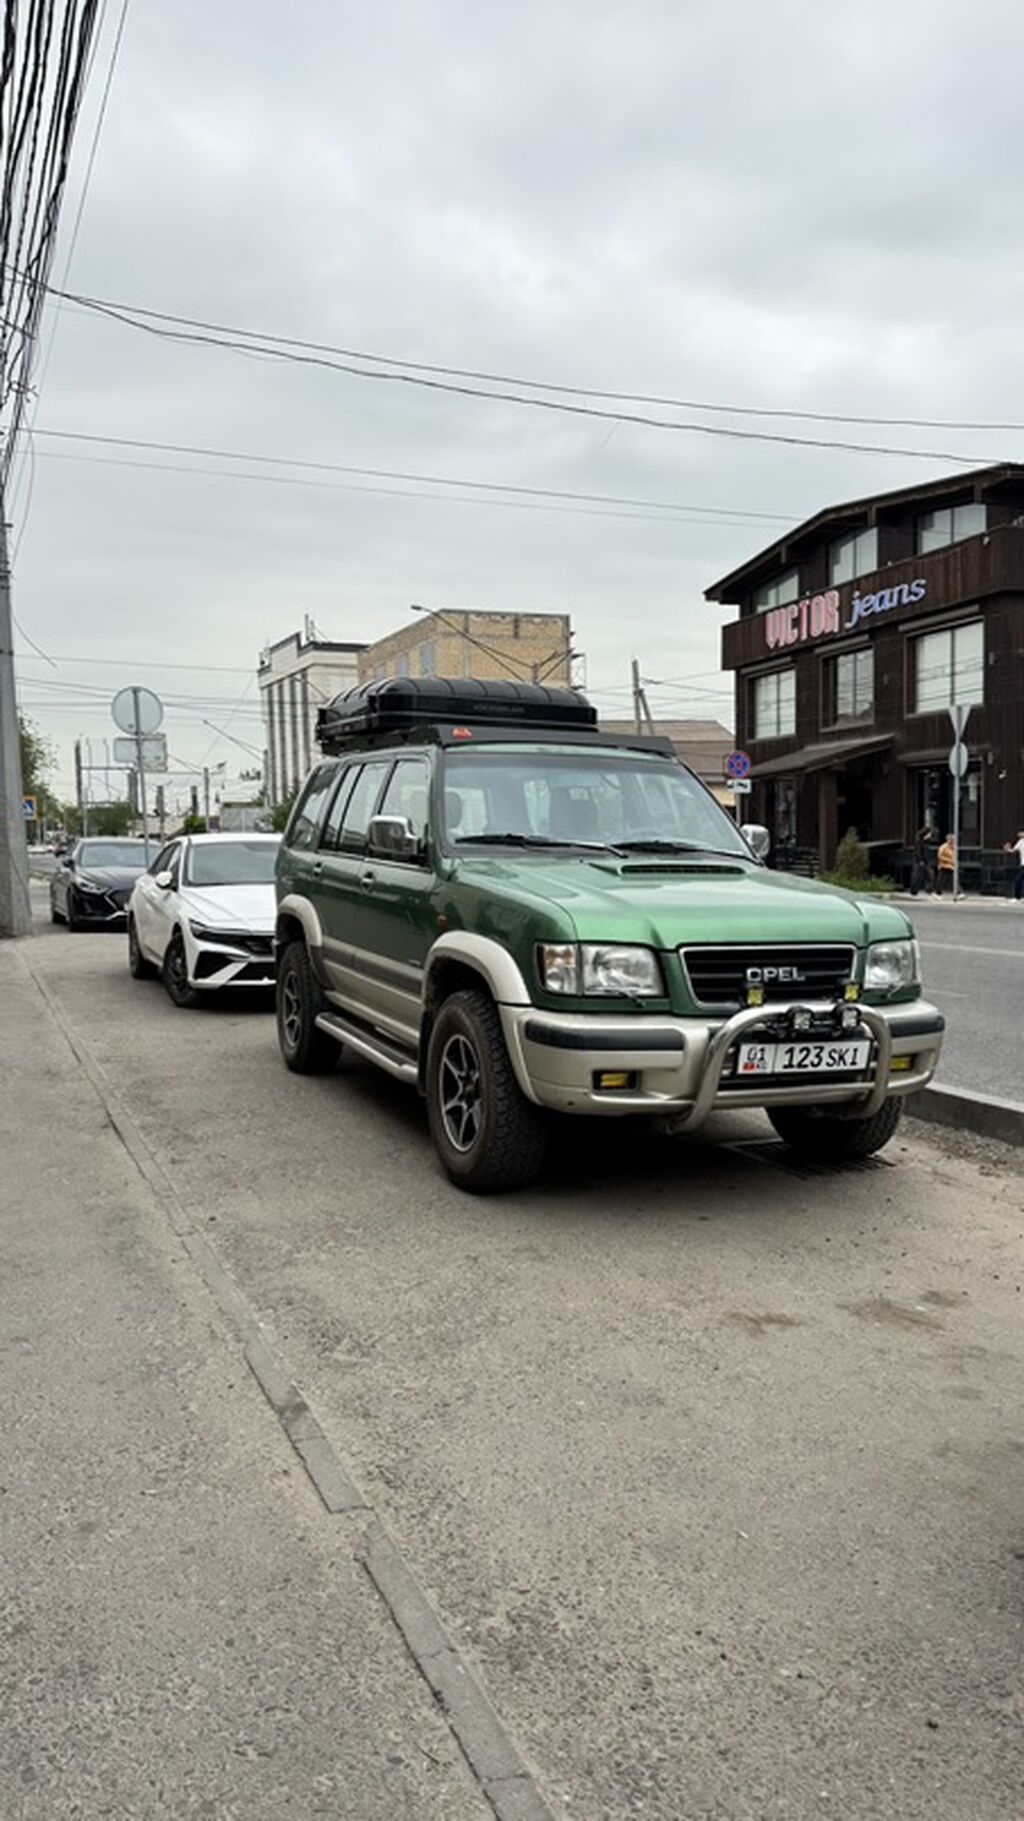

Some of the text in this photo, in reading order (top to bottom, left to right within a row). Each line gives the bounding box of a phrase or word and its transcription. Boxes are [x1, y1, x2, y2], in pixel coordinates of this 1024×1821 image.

[765, 579, 926, 648] VICTOR jeans
[746, 967, 806, 982] OPEL
[747, 1047, 765, 1061] 01
